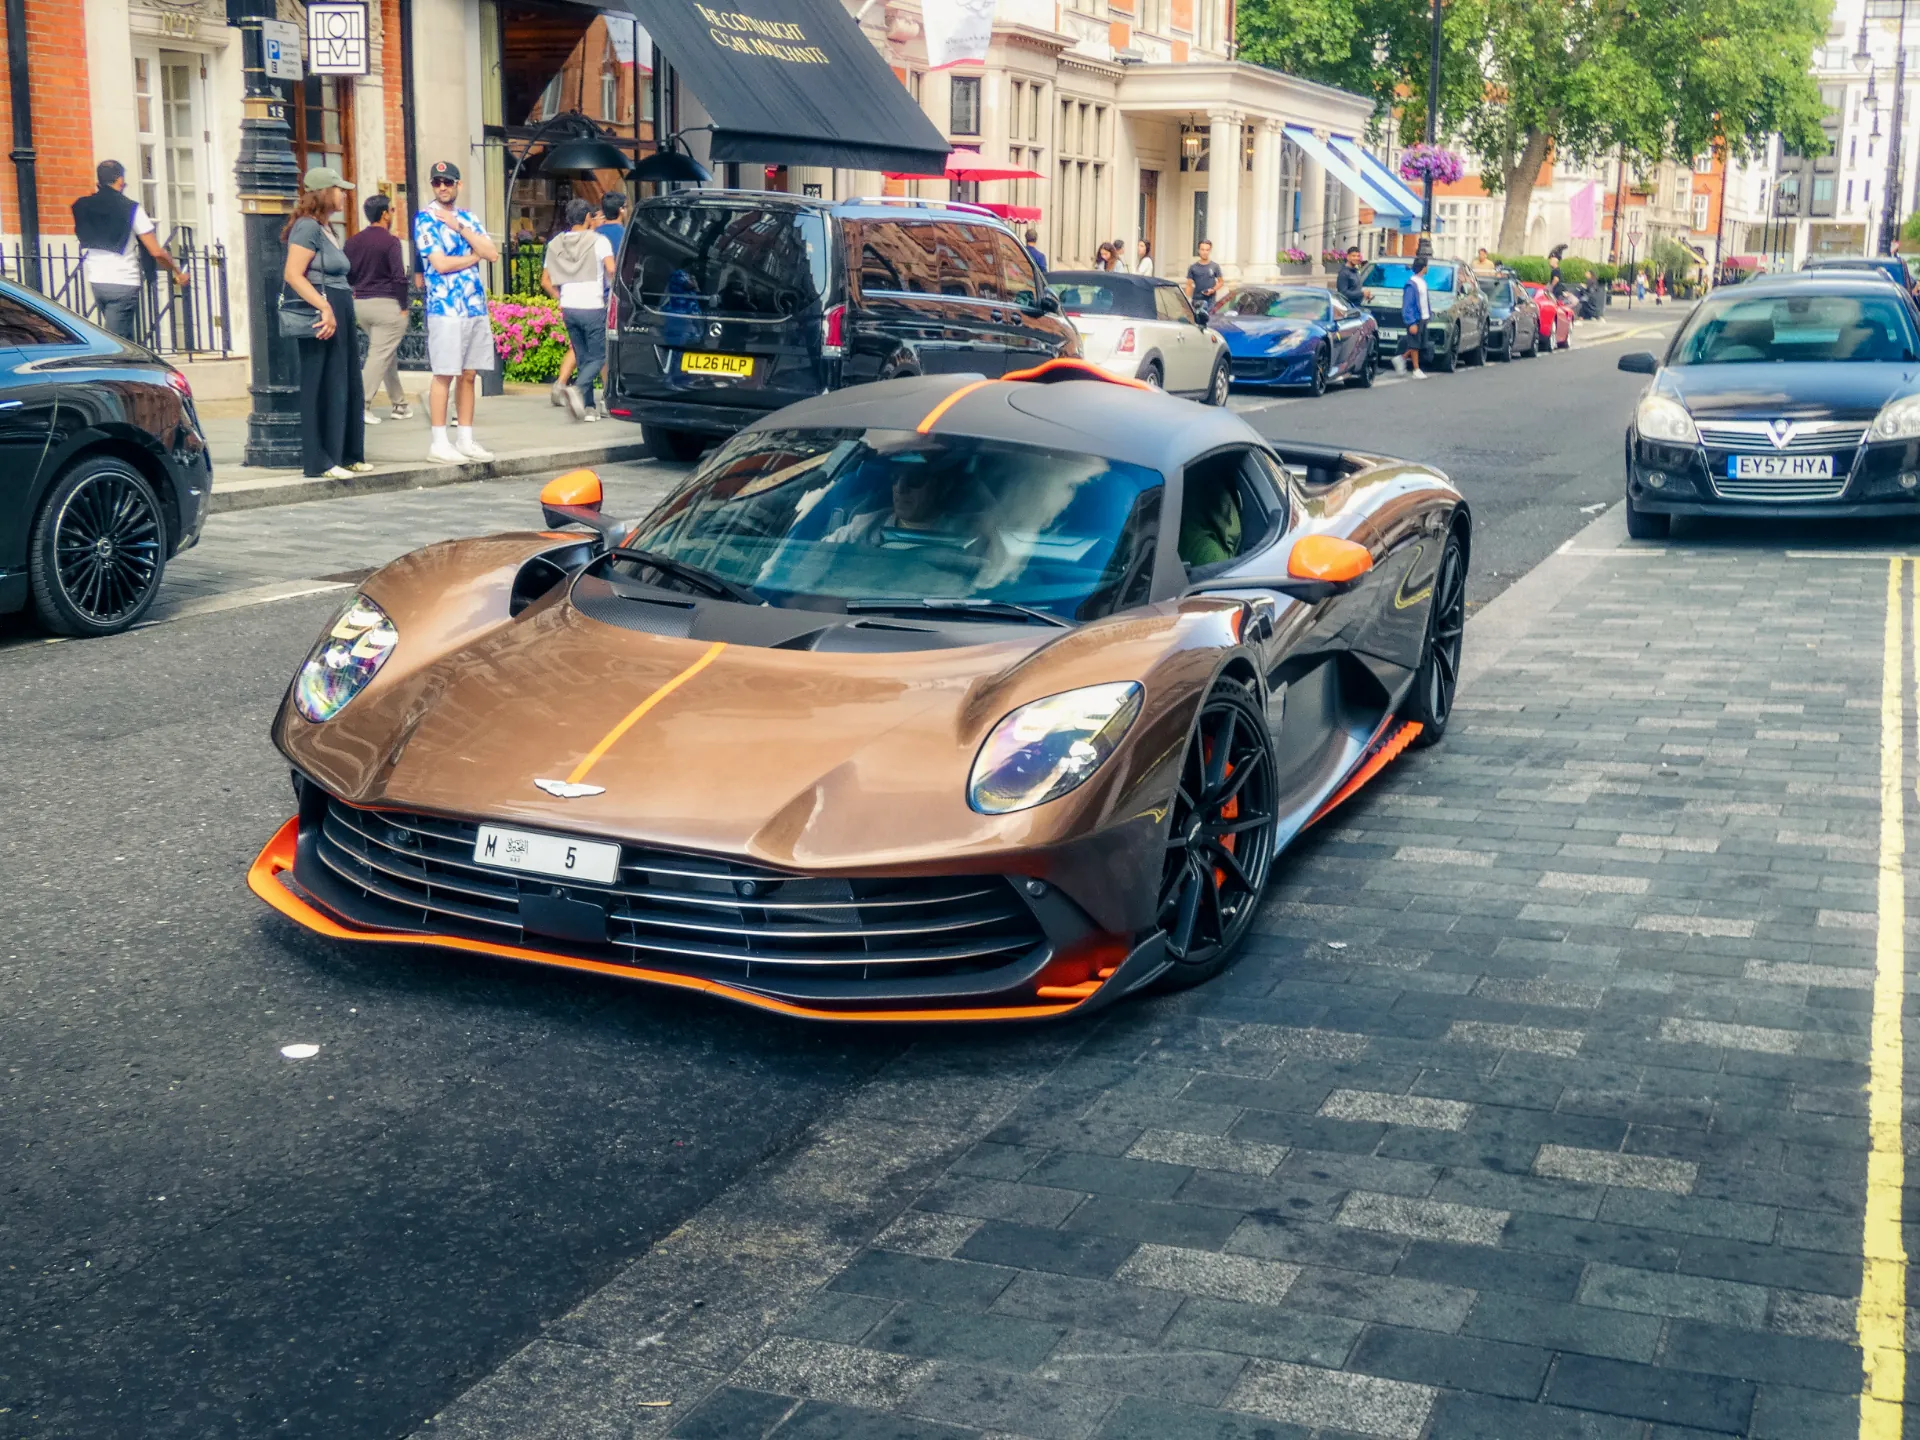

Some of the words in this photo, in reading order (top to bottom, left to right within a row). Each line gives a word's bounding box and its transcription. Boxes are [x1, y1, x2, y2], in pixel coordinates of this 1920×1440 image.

[693, 2, 726, 27] THE
[719, 12, 806, 40] CONNAUGHT
[268, 40, 279, 59] P
[710, 28, 756, 55] CIGAR
[749, 38, 830, 64] MERCHANTS
[269, 106, 285, 118] 15
[687, 355, 719, 370] LL26
[721, 358, 747, 372] HLP
[1740, 458, 1788, 474] EY57
[1793, 458, 1829, 474] HYA
[484, 834, 498, 858] M
[565, 846, 578, 869] 5
